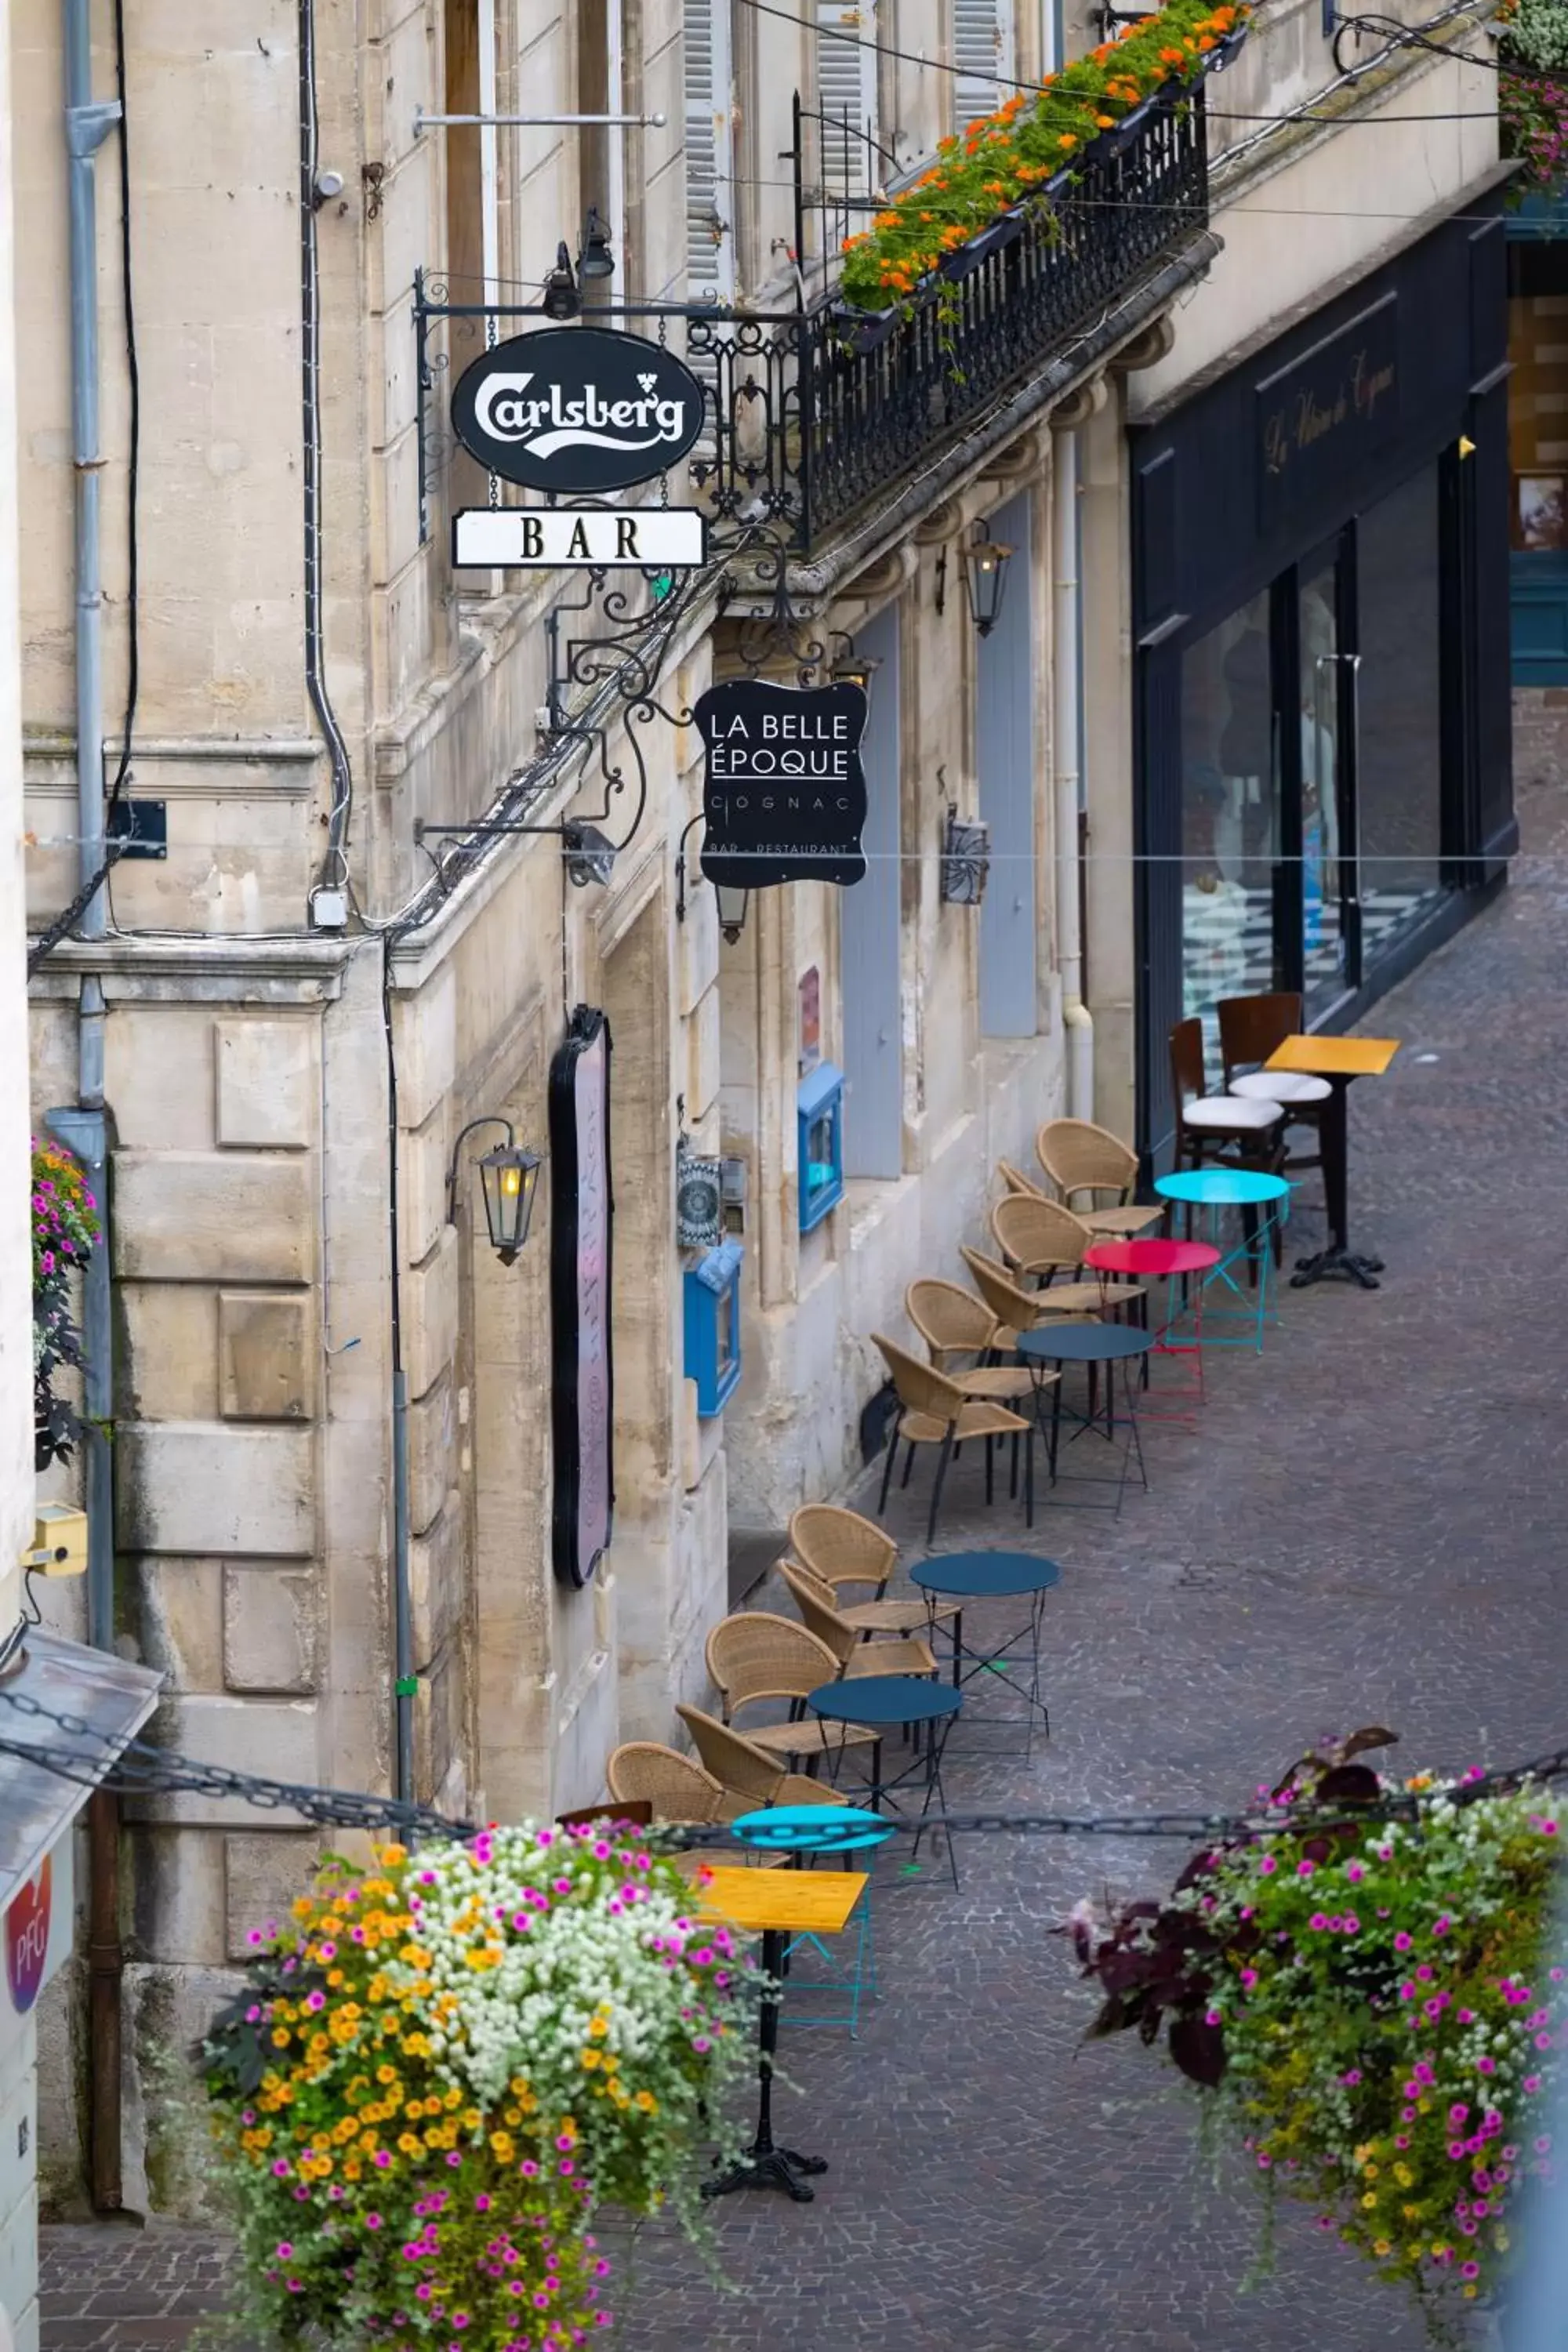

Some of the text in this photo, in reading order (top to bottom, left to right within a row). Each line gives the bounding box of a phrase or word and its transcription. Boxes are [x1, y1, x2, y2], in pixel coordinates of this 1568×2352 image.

[474, 372, 686, 442] Carlsberg
[520, 516, 643, 559] BAR
[711, 714, 848, 739] LA BELLE
[711, 742, 848, 775] ÉPOQUE
[710, 796, 849, 810] COGNAC
[710, 842, 848, 855] BAR RESTAURANT
[15, 1908, 45, 1985] PFG
